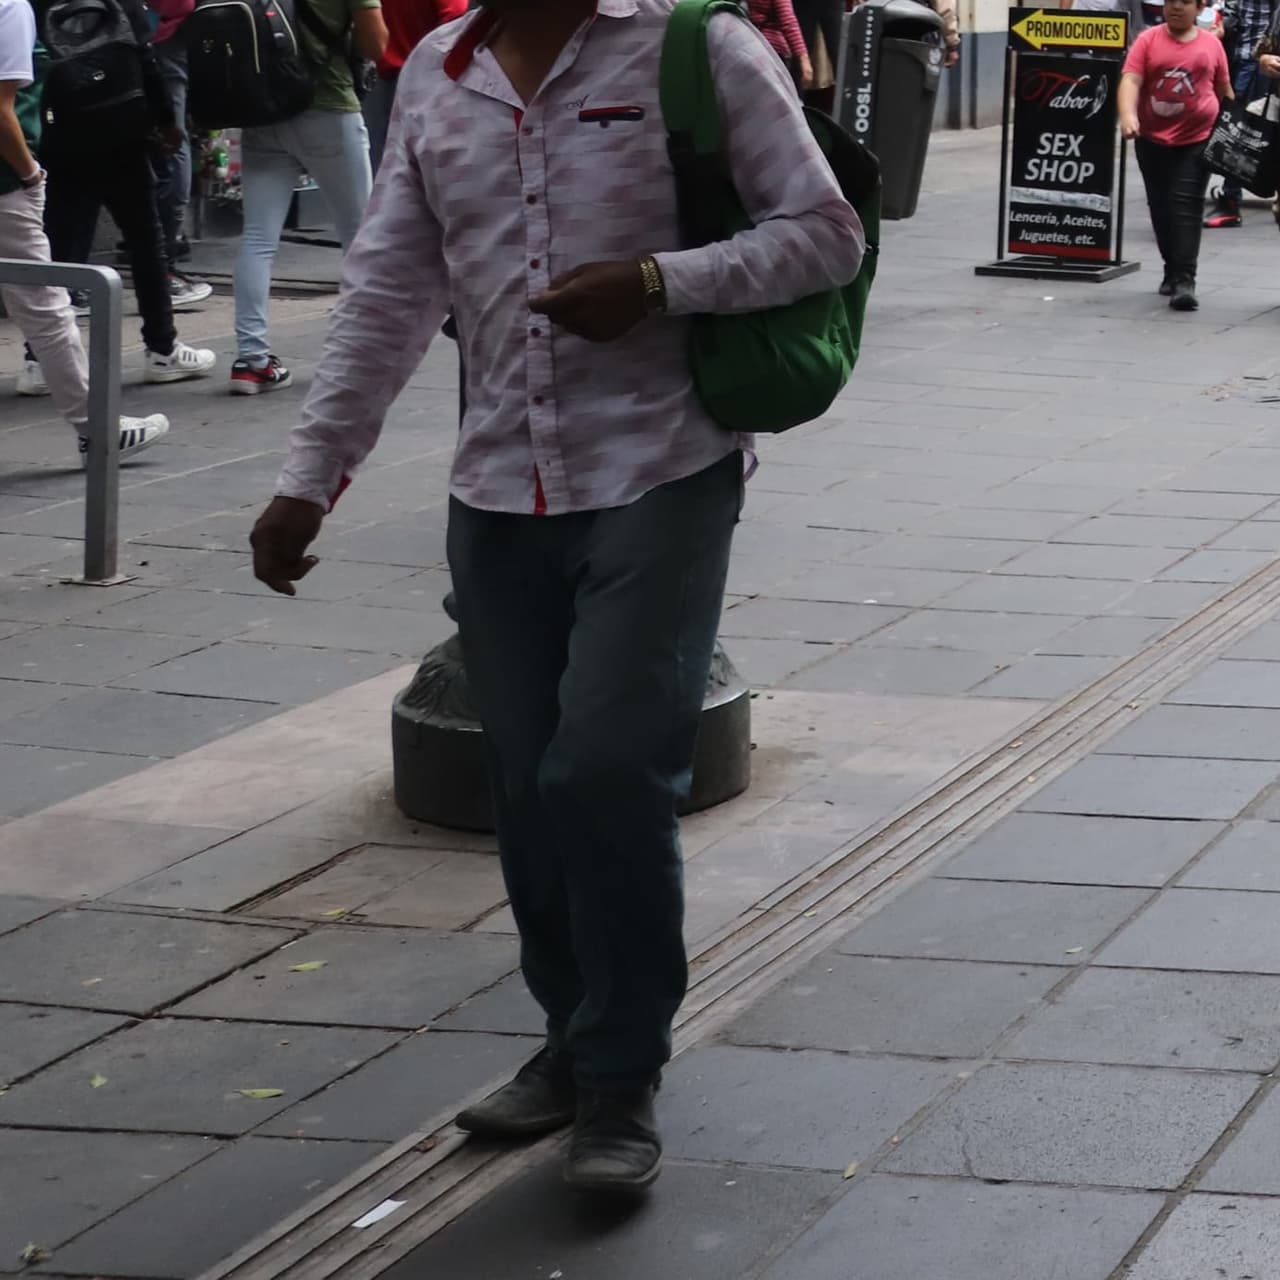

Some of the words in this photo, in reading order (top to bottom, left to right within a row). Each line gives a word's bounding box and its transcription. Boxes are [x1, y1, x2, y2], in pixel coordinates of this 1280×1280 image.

[1026, 20, 1121, 41] PROMOCIONES
[1022, 70, 1092, 109] Taboo
[855, 82, 873, 133] OOSL
[1036, 132, 1085, 158] SEX
[1024, 158, 1095, 185] SHOP
[1062, 213, 1107, 230] Aceites,
[1019, 228, 1072, 245] Juguetes,
[1074, 233, 1097, 246] etc.
